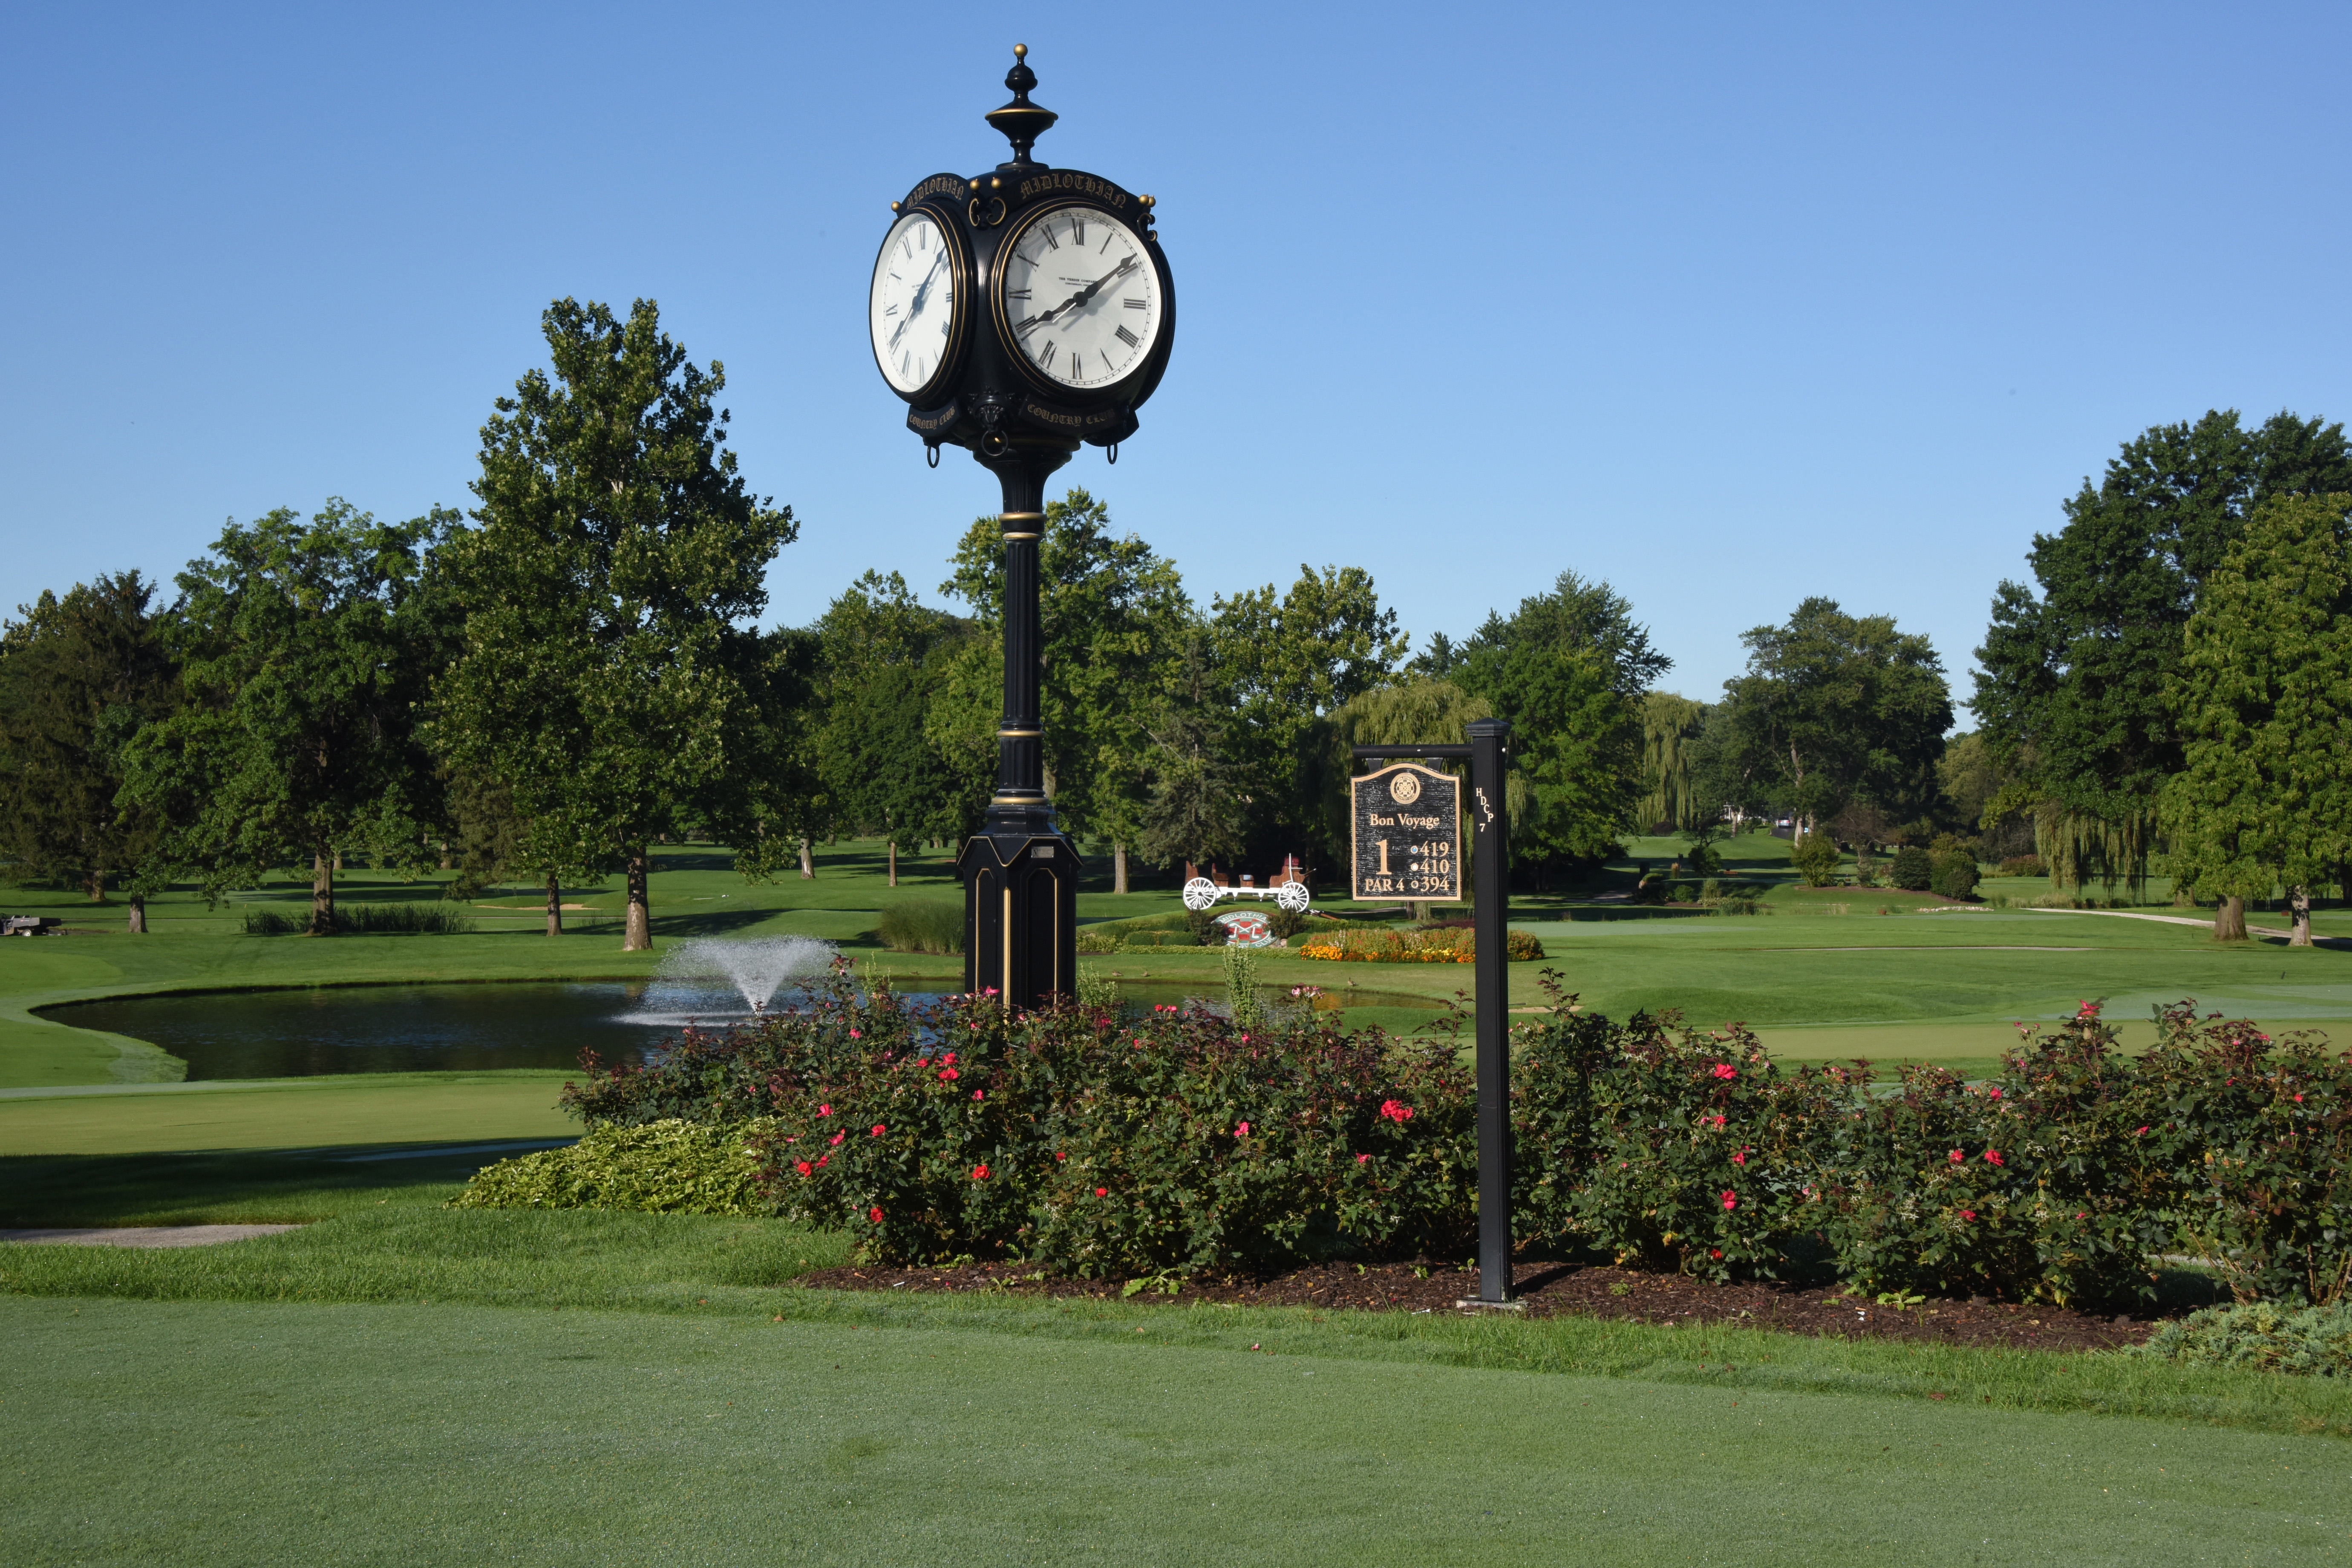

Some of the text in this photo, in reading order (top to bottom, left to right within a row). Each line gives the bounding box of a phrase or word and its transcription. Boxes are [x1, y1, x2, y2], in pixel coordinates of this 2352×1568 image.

[907, 177, 963, 209] MIDLOTHIAN
[1020, 173, 1126, 209] MIDLOTHIAN
[1039, 224, 1060, 254] XI
[1072, 218, 1085, 246] XII
[1099, 232, 1114, 255] I
[1016, 249, 1040, 272] X
[1008, 287, 1032, 301] IX
[1124, 297, 1146, 310] III
[1114, 323, 1140, 349] IIII
[1037, 339, 1057, 370] VII
[1071, 352, 1083, 380] VI
[1100, 347, 1114, 373] V
[909, 406, 955, 429] COUNTRY CLUB
[1027, 404, 1081, 427] COUNTRY
[1476, 787, 1494, 822] HDCP
[1370, 813, 1439, 829] Bon Voyage
[1479, 823, 1486, 832] 7
[1375, 839, 1392, 875] 1
[1420, 841, 1449, 857] 419
[1420, 858, 1449, 874] 410
[1365, 878, 1404, 891] PAR 4
[1421, 876, 1450, 892] 394
[1219, 913, 1268, 924] MIDLOTHIA
